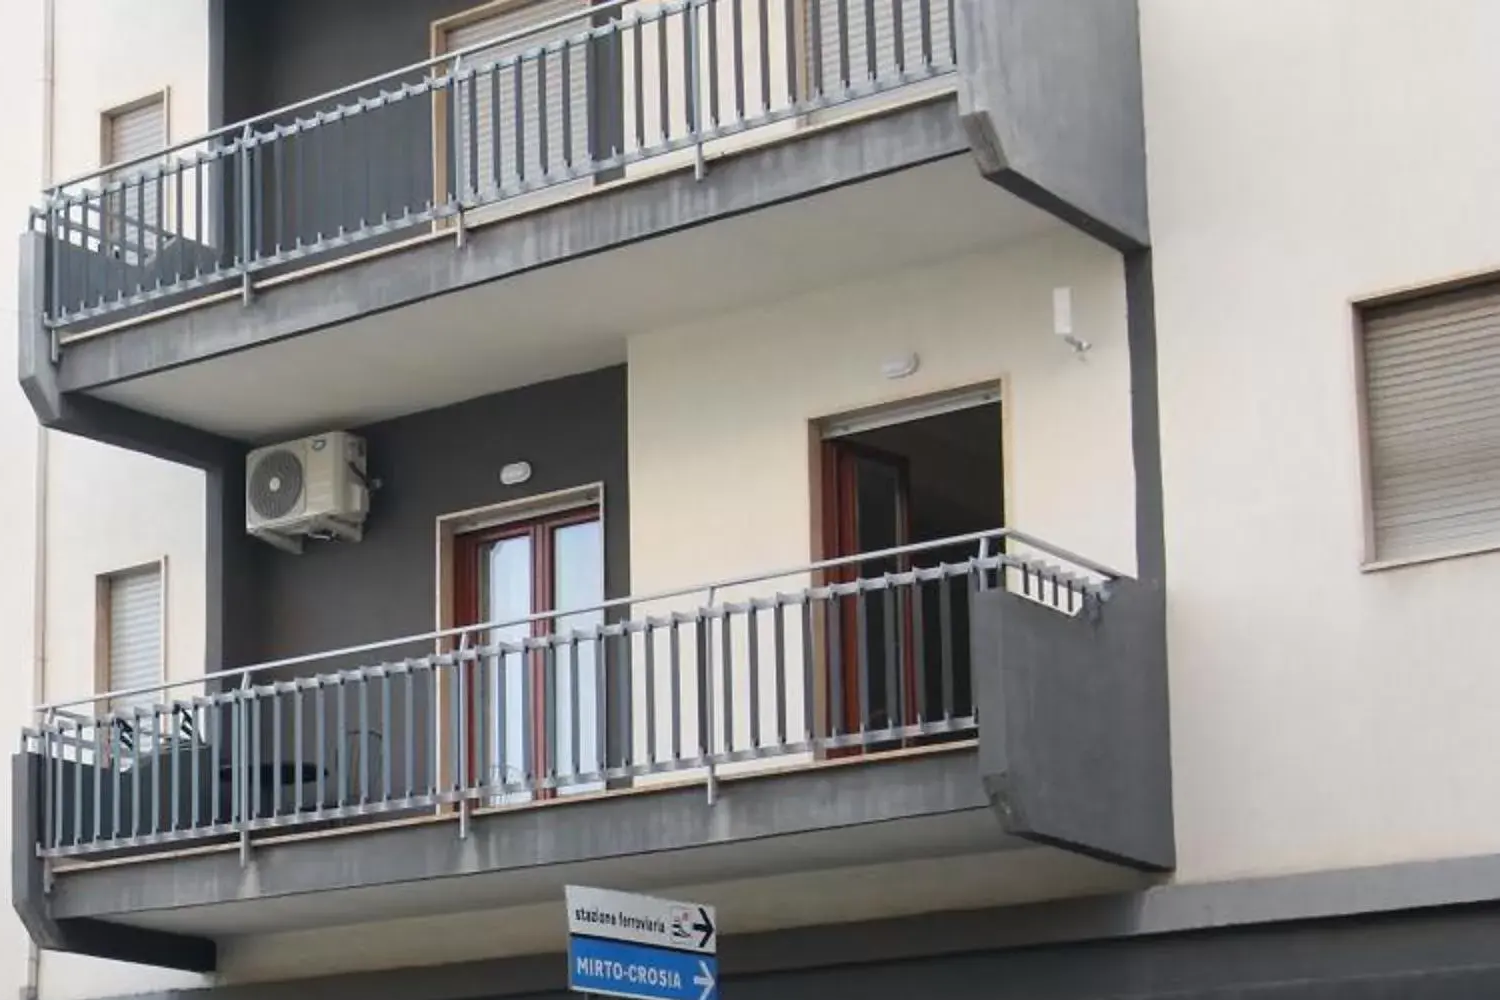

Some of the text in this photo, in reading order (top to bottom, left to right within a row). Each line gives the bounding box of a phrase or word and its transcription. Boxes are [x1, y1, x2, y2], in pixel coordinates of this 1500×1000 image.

[575, 907, 665, 933] stazione ferroviaria
[576, 955, 682, 990] MIRTO-CROSIA
